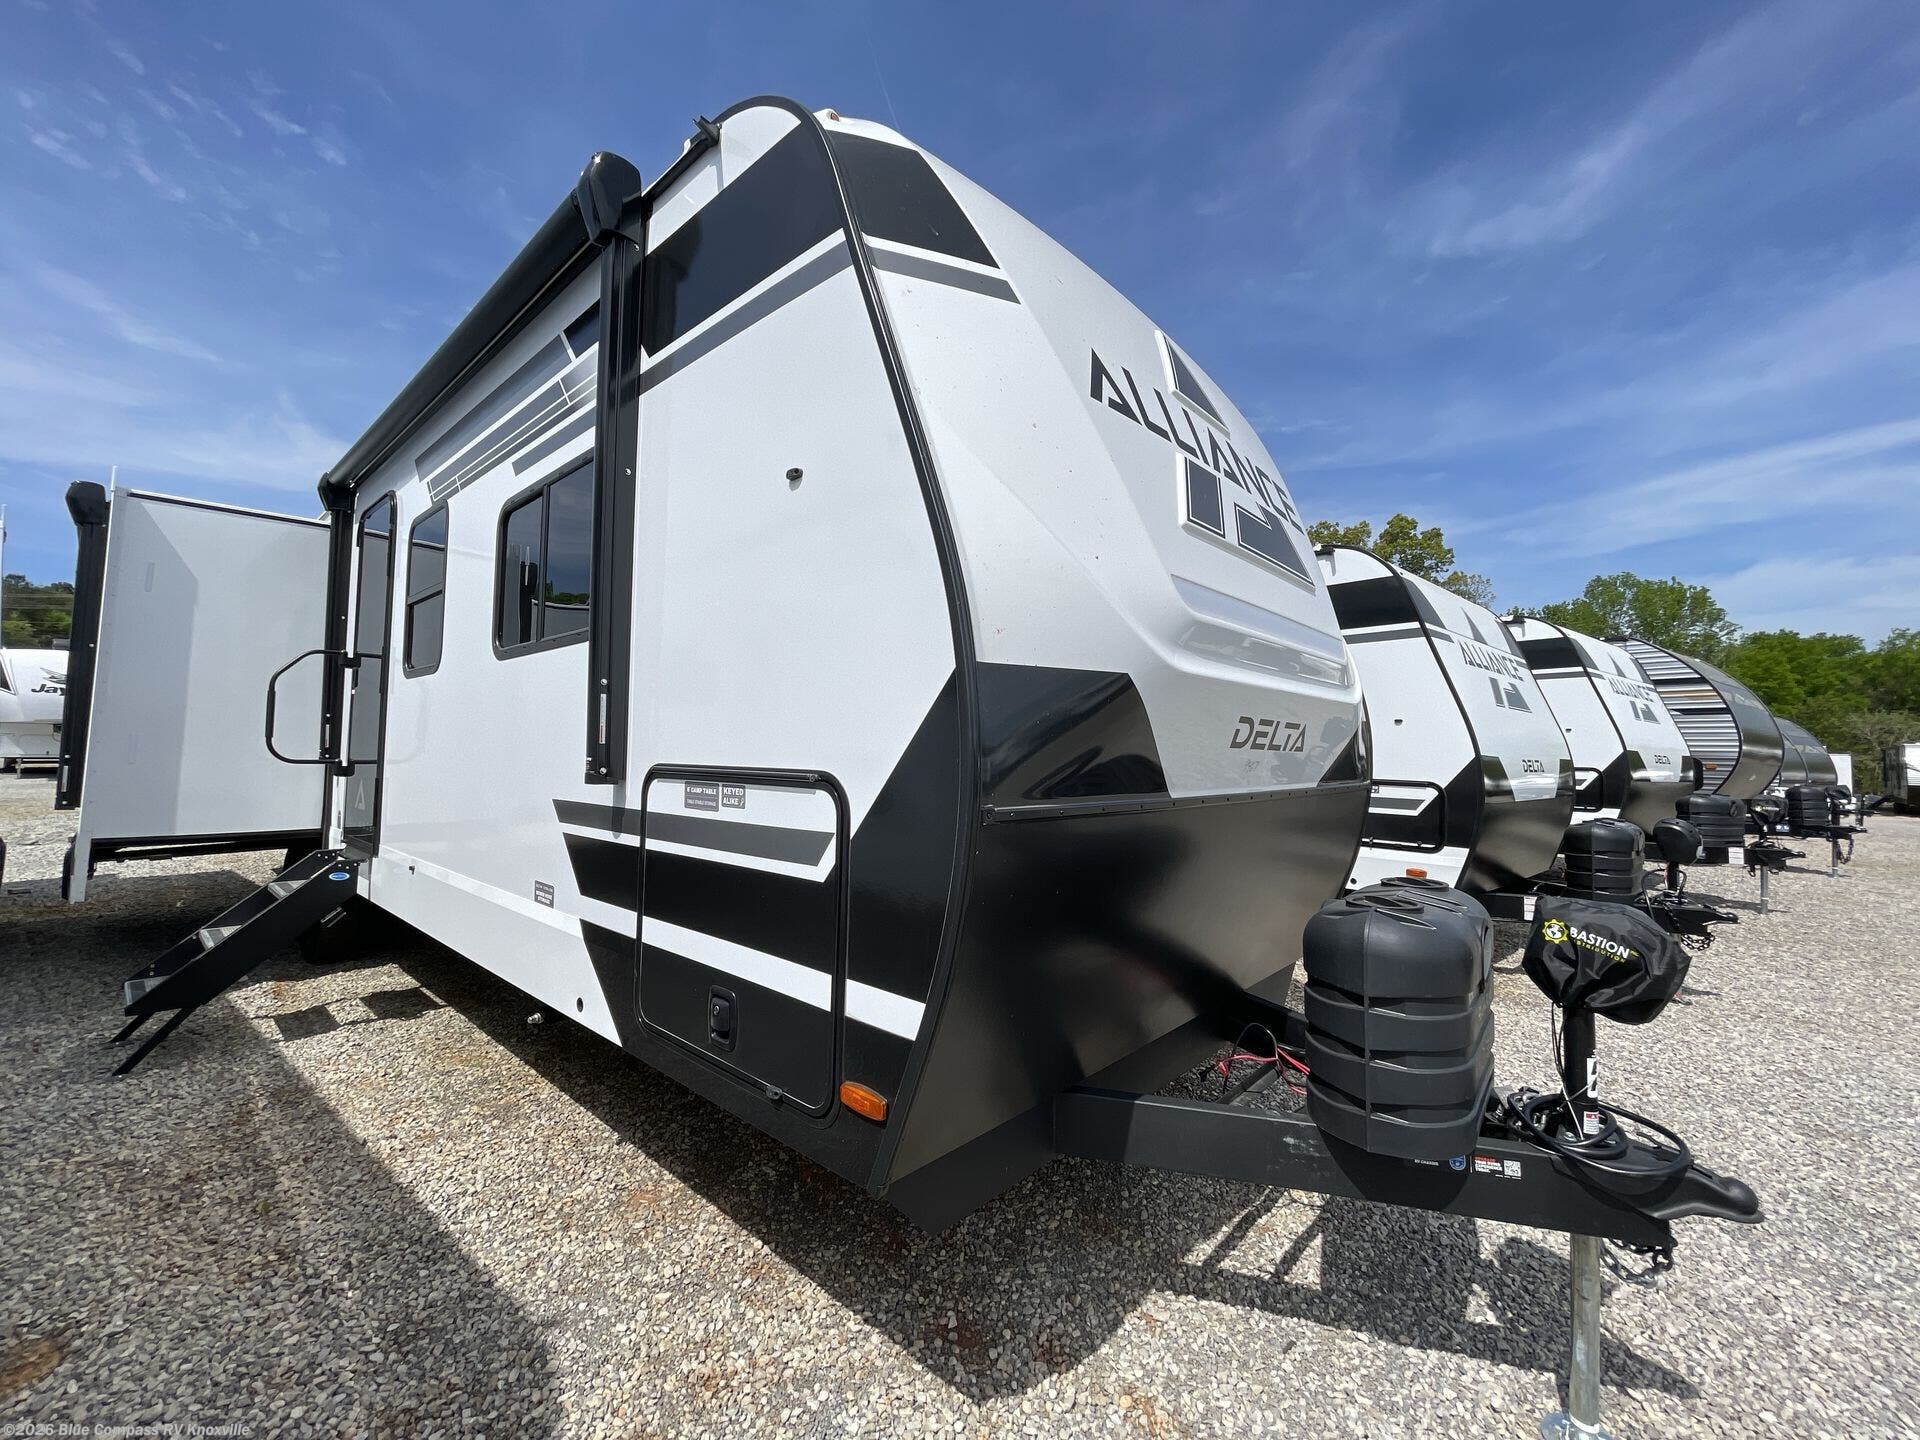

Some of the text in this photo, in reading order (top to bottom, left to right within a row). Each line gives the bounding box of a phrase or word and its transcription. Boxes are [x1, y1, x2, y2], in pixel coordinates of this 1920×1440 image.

[1090, 348, 1305, 536] ALLIANCE
[1458, 640, 1524, 682] ALLIANCE
[1229, 715, 1307, 752] DELTA
[1522, 759, 1545, 773] DELTA
[723, 787, 744, 796] KEYED
[723, 797, 739, 805] ALIKE
[1570, 927, 1630, 958] BASTION
